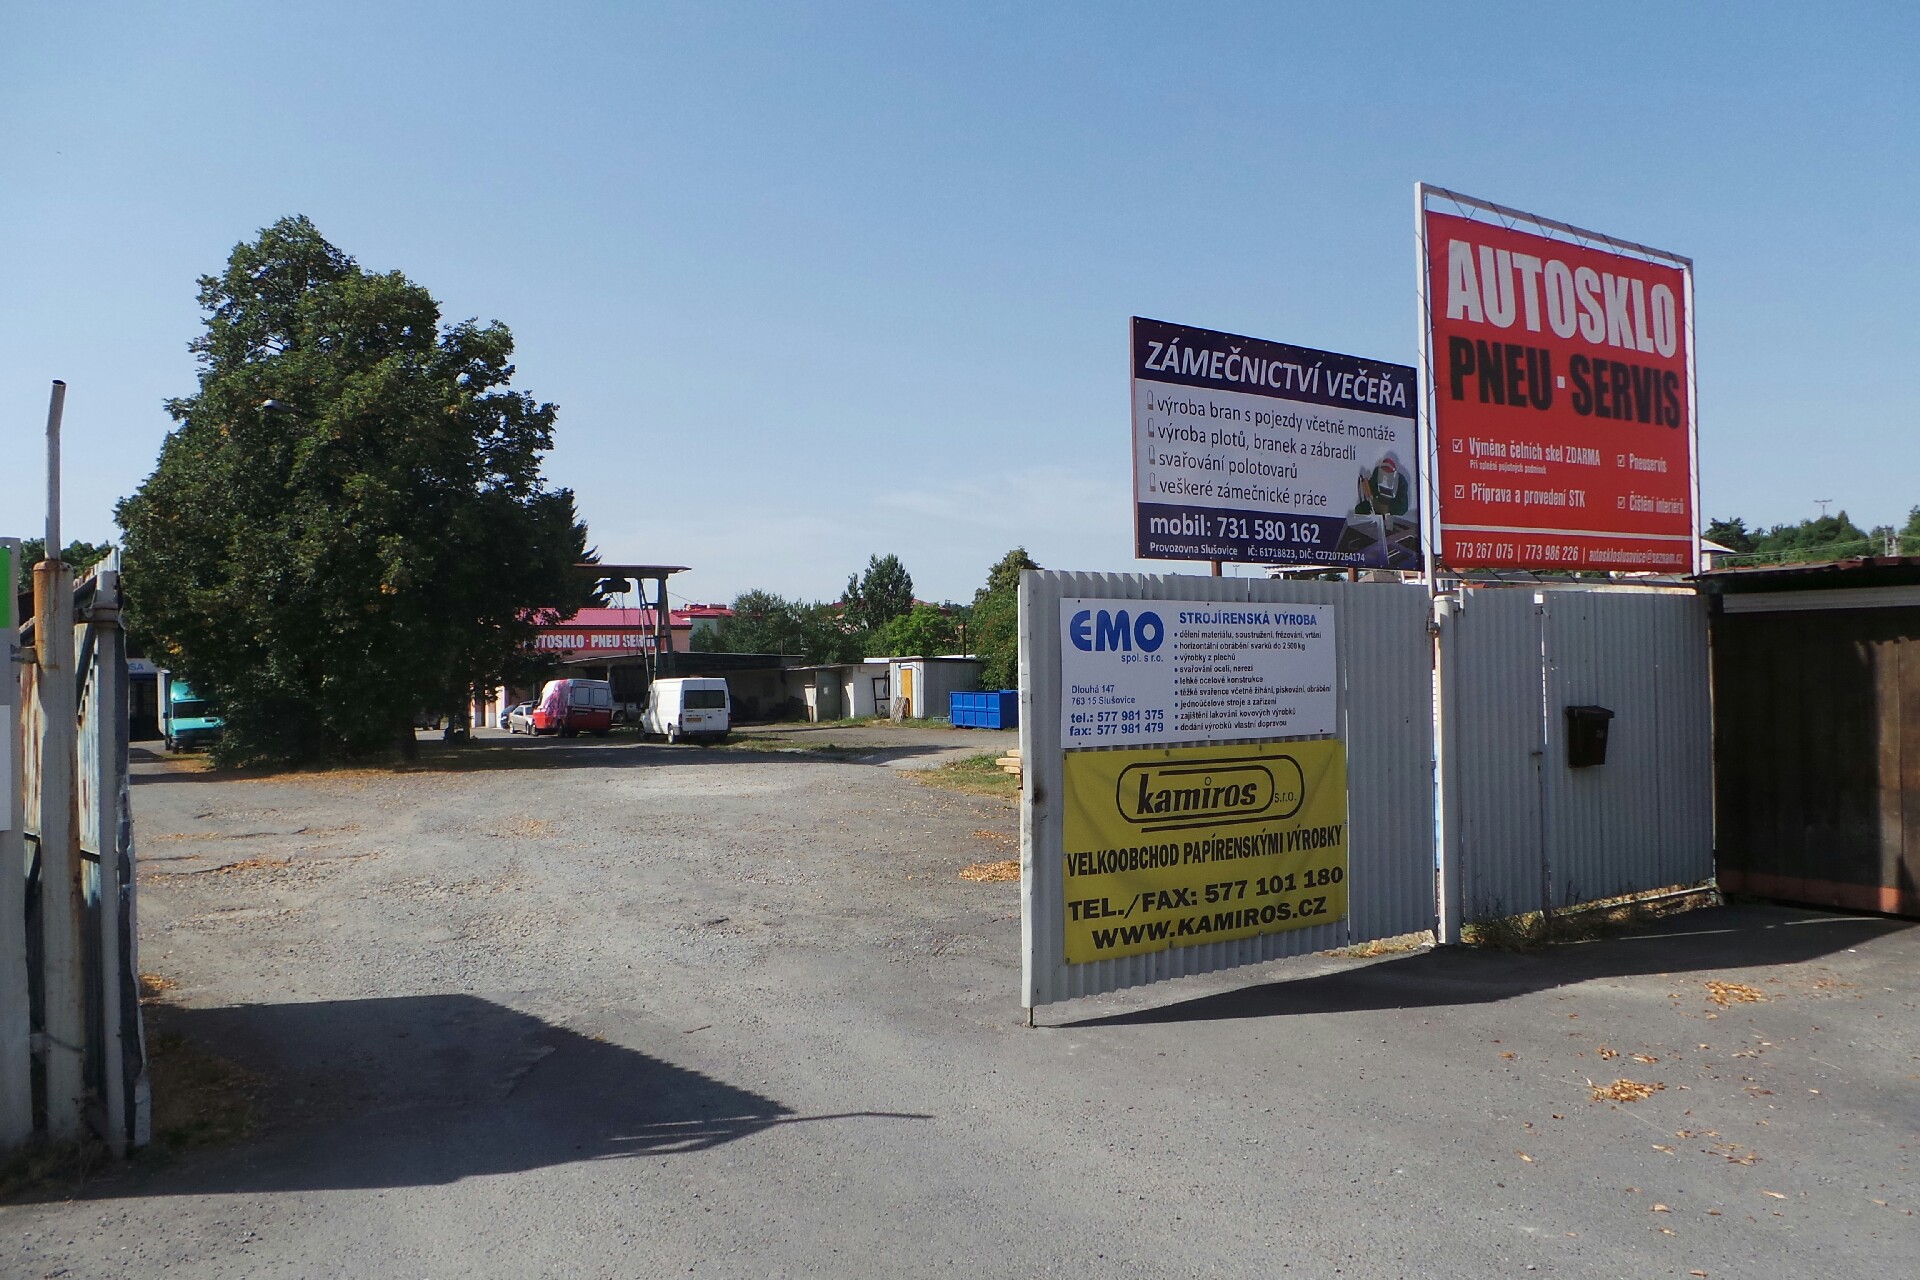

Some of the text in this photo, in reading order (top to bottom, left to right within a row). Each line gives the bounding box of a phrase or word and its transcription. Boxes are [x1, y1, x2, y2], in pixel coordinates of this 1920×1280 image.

[1446, 239, 1676, 358] AUTOSKLO
[1145, 337, 1406, 409] ZÁMEČNICTVÍ VEČEŘA
[1449, 335, 1680, 429] PNEU SERVIS
[1157, 396, 1396, 442] výroba bran s pojezdy včetně montáže
[1158, 423, 1356, 461] výroba plotů, branek a zábradlí
[1469, 437, 1601, 466] Výměna čelních skel ZDARMA
[1159, 451, 1297, 479] svařování polotovarů
[1629, 452, 1667, 473] Pneuservis
[1160, 478, 1327, 508] veškeré zámečnické práce
[1471, 483, 1586, 508] Příprava a provedení STK
[1150, 513, 1321, 544] mobil: 731 580 162
[1150, 542, 1199, 553] Provozovna
[1201, 544, 1238, 556] Slušovice
[1248, 544, 1258, 557] IČ:
[1259, 548, 1298, 560] 61718823,
[1300, 548, 1314, 559] DIČ:
[1456, 542, 1473, 559] 773
[1476, 542, 1493, 559] 267
[1496, 543, 1514, 559] 075
[1525, 544, 1542, 560] 773
[1545, 545, 1560, 561] 986
[1562, 546, 1579, 561] 226
[1179, 610, 1317, 626] STROJÍRENSKÁ VÝROBA
[1069, 609, 1165, 653] EMO
[1180, 630, 1200, 639] dělení
[1201, 630, 1234, 639] materiálu,
[1235, 630, 1275, 639] soustružení,
[1275, 630, 1305, 639] frézování,
[590, 634, 620, 648] PNEU
[1180, 641, 1219, 650] horizontální
[1220, 641, 1249, 650] obrábění
[1250, 642, 1272, 650] svarků
[1273, 642, 1282, 650] do
[1121, 653, 1142, 665] spol.
[1151, 654, 1164, 662] r.o.
[1180, 653, 1207, 663] výrobky
[1213, 653, 1236, 662] plechů
[1180, 664, 1213, 673] svařování
[1213, 664, 1232, 674] oceli,
[1071, 684, 1115, 694] Dlouhá 147
[1180, 675, 1264, 685] lehké ocelové konstrukce
[1071, 695, 1136, 706] 763 15 Slušovice
[1180, 688, 1198, 697] těžké
[1231, 686, 1253, 695] včetně
[1180, 699, 1225, 710] jednoúčelové
[1226, 698, 1246, 708] stroje
[1252, 697, 1277, 706] zařízení
[1070, 709, 1164, 724] tel.: 577 981 375
[1180, 710, 1208, 721] zajištění
[1209, 709, 1238, 719] lakování
[1239, 708, 1271, 718] kovových
[1069, 722, 1164, 737] fax: 577 981 479
[1180, 719, 1287, 732] dodání výrobků vlastní dopravou
[1136, 773, 1297, 815] kamiros s.r.o.
[1067, 823, 1343, 877] VELKOOBCHOD PAPÍRENSKÝMI VÝROBKY
[1068, 866, 1344, 922] TEL./FAX: 577 101 180
[1091, 896, 1327, 950] WWW.KAMIROS.CZ
